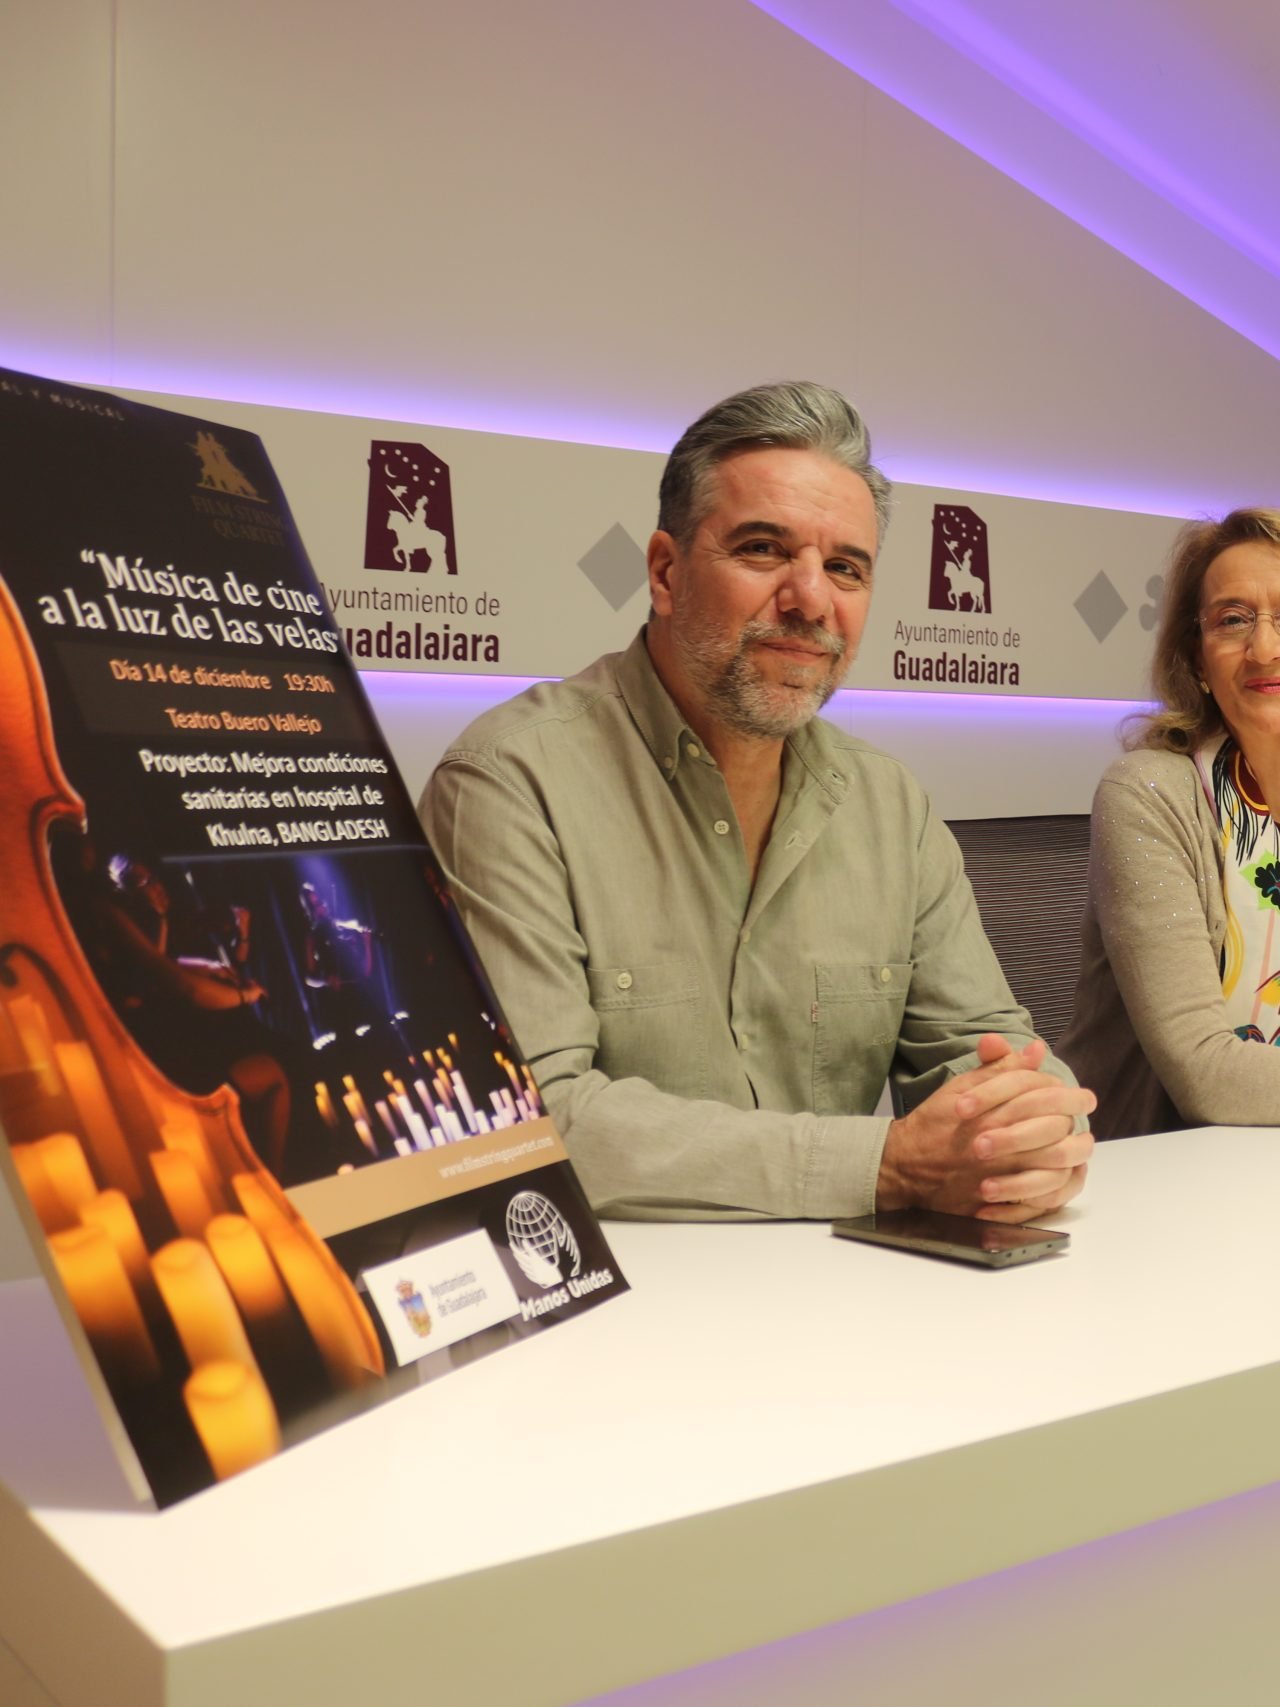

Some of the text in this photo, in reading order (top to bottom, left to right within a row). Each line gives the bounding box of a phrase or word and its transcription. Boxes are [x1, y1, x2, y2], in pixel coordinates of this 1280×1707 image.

[224, 572, 260, 607] de
[266, 581, 324, 617] cine
[320, 582, 500, 616] yuntamiento de
[38, 595, 66, 625] a
[63, 588, 107, 631] la
[106, 594, 167, 637] luz
[170, 604, 213, 641] de
[211, 608, 264, 646] las
[894, 620, 1020, 648] Ayuntamiento de
[109, 658, 336, 694] Día 14 de diciembre 19:30h
[894, 650, 1020, 686] Guadalajara
[164, 708, 323, 735] Teatro Buero Vallejo
[138, 749, 388, 778] Proyecto: Mejora condiciones
[181, 785, 384, 811] sanitarias en hospital de
[205, 818, 390, 848] Khulna, BANGLADESH
[521, 1268, 614, 1321] Manos Unidas
